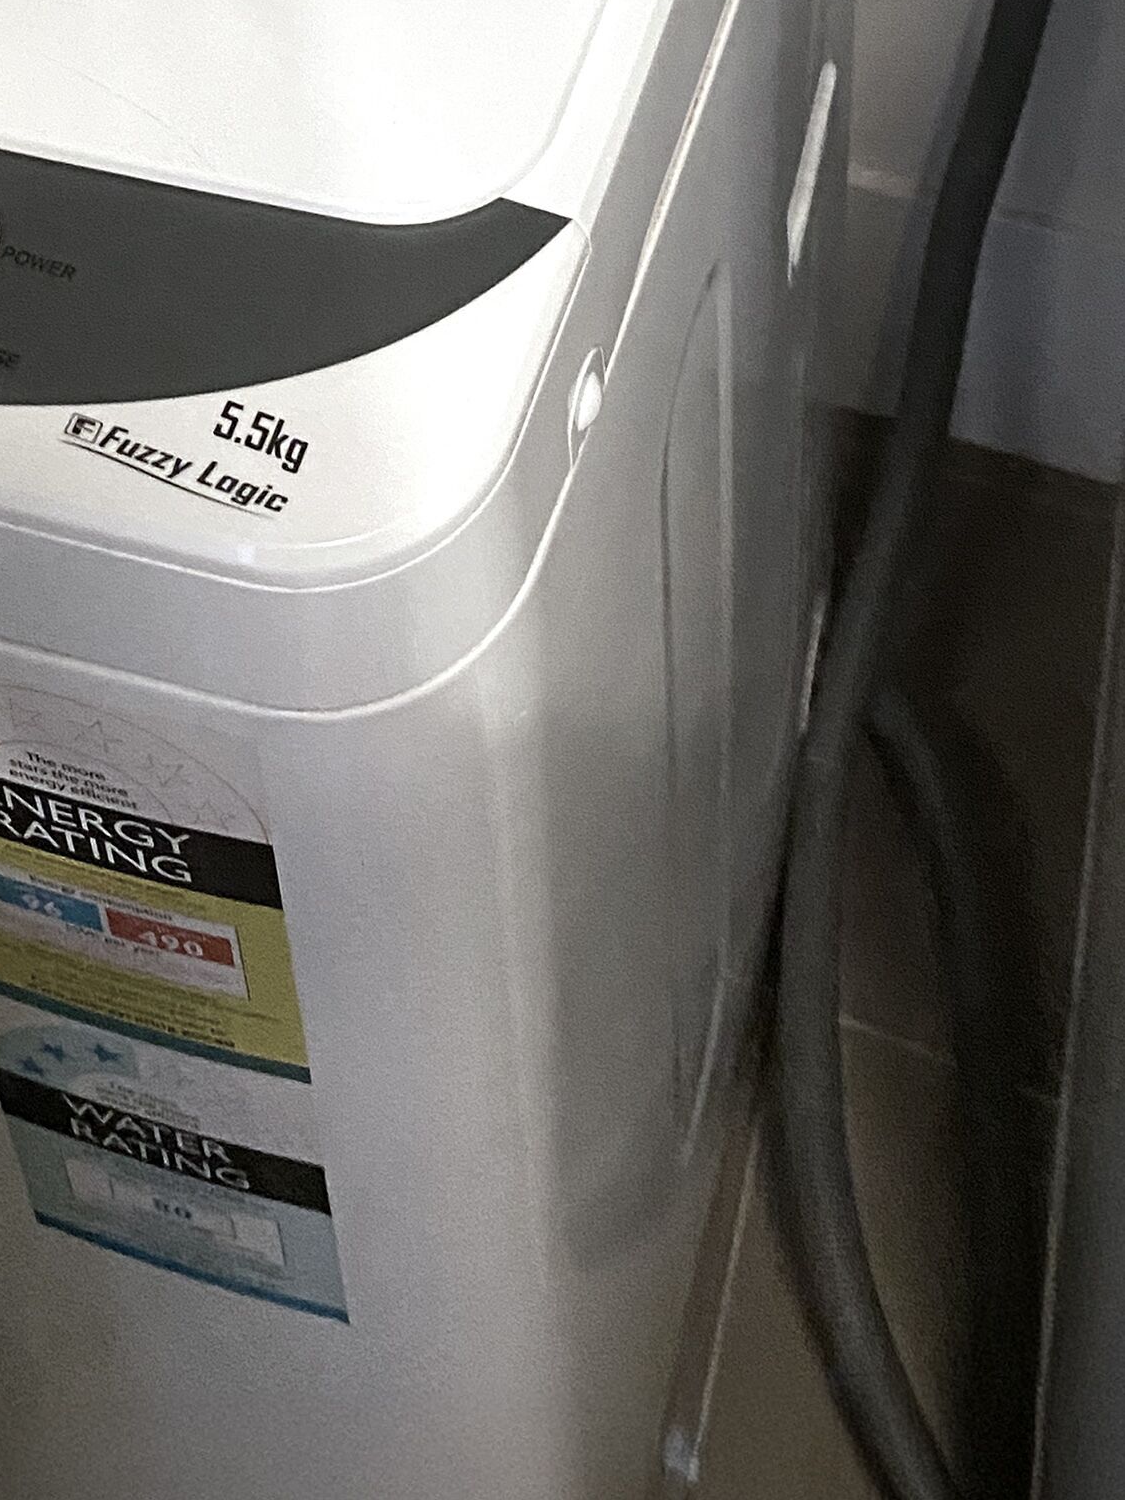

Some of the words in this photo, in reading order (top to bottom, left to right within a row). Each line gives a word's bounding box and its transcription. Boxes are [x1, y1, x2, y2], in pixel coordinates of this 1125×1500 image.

[0, 245, 76, 280] POWER
[212, 400, 309, 474] 5.5kg
[98, 425, 193, 479] Fuzzy
[196, 460, 290, 513] Logic
[9, 758, 47, 776] stars
[51, 770, 79, 785] the
[84, 780, 129, 798] more
[9, 768, 66, 792] energy
[70, 786, 138, 810] efficient
[26, 751, 57, 767] The
[61, 764, 107, 781] more
[62, 1092, 233, 1164] WATER
[70, 1116, 250, 1190] RATING
